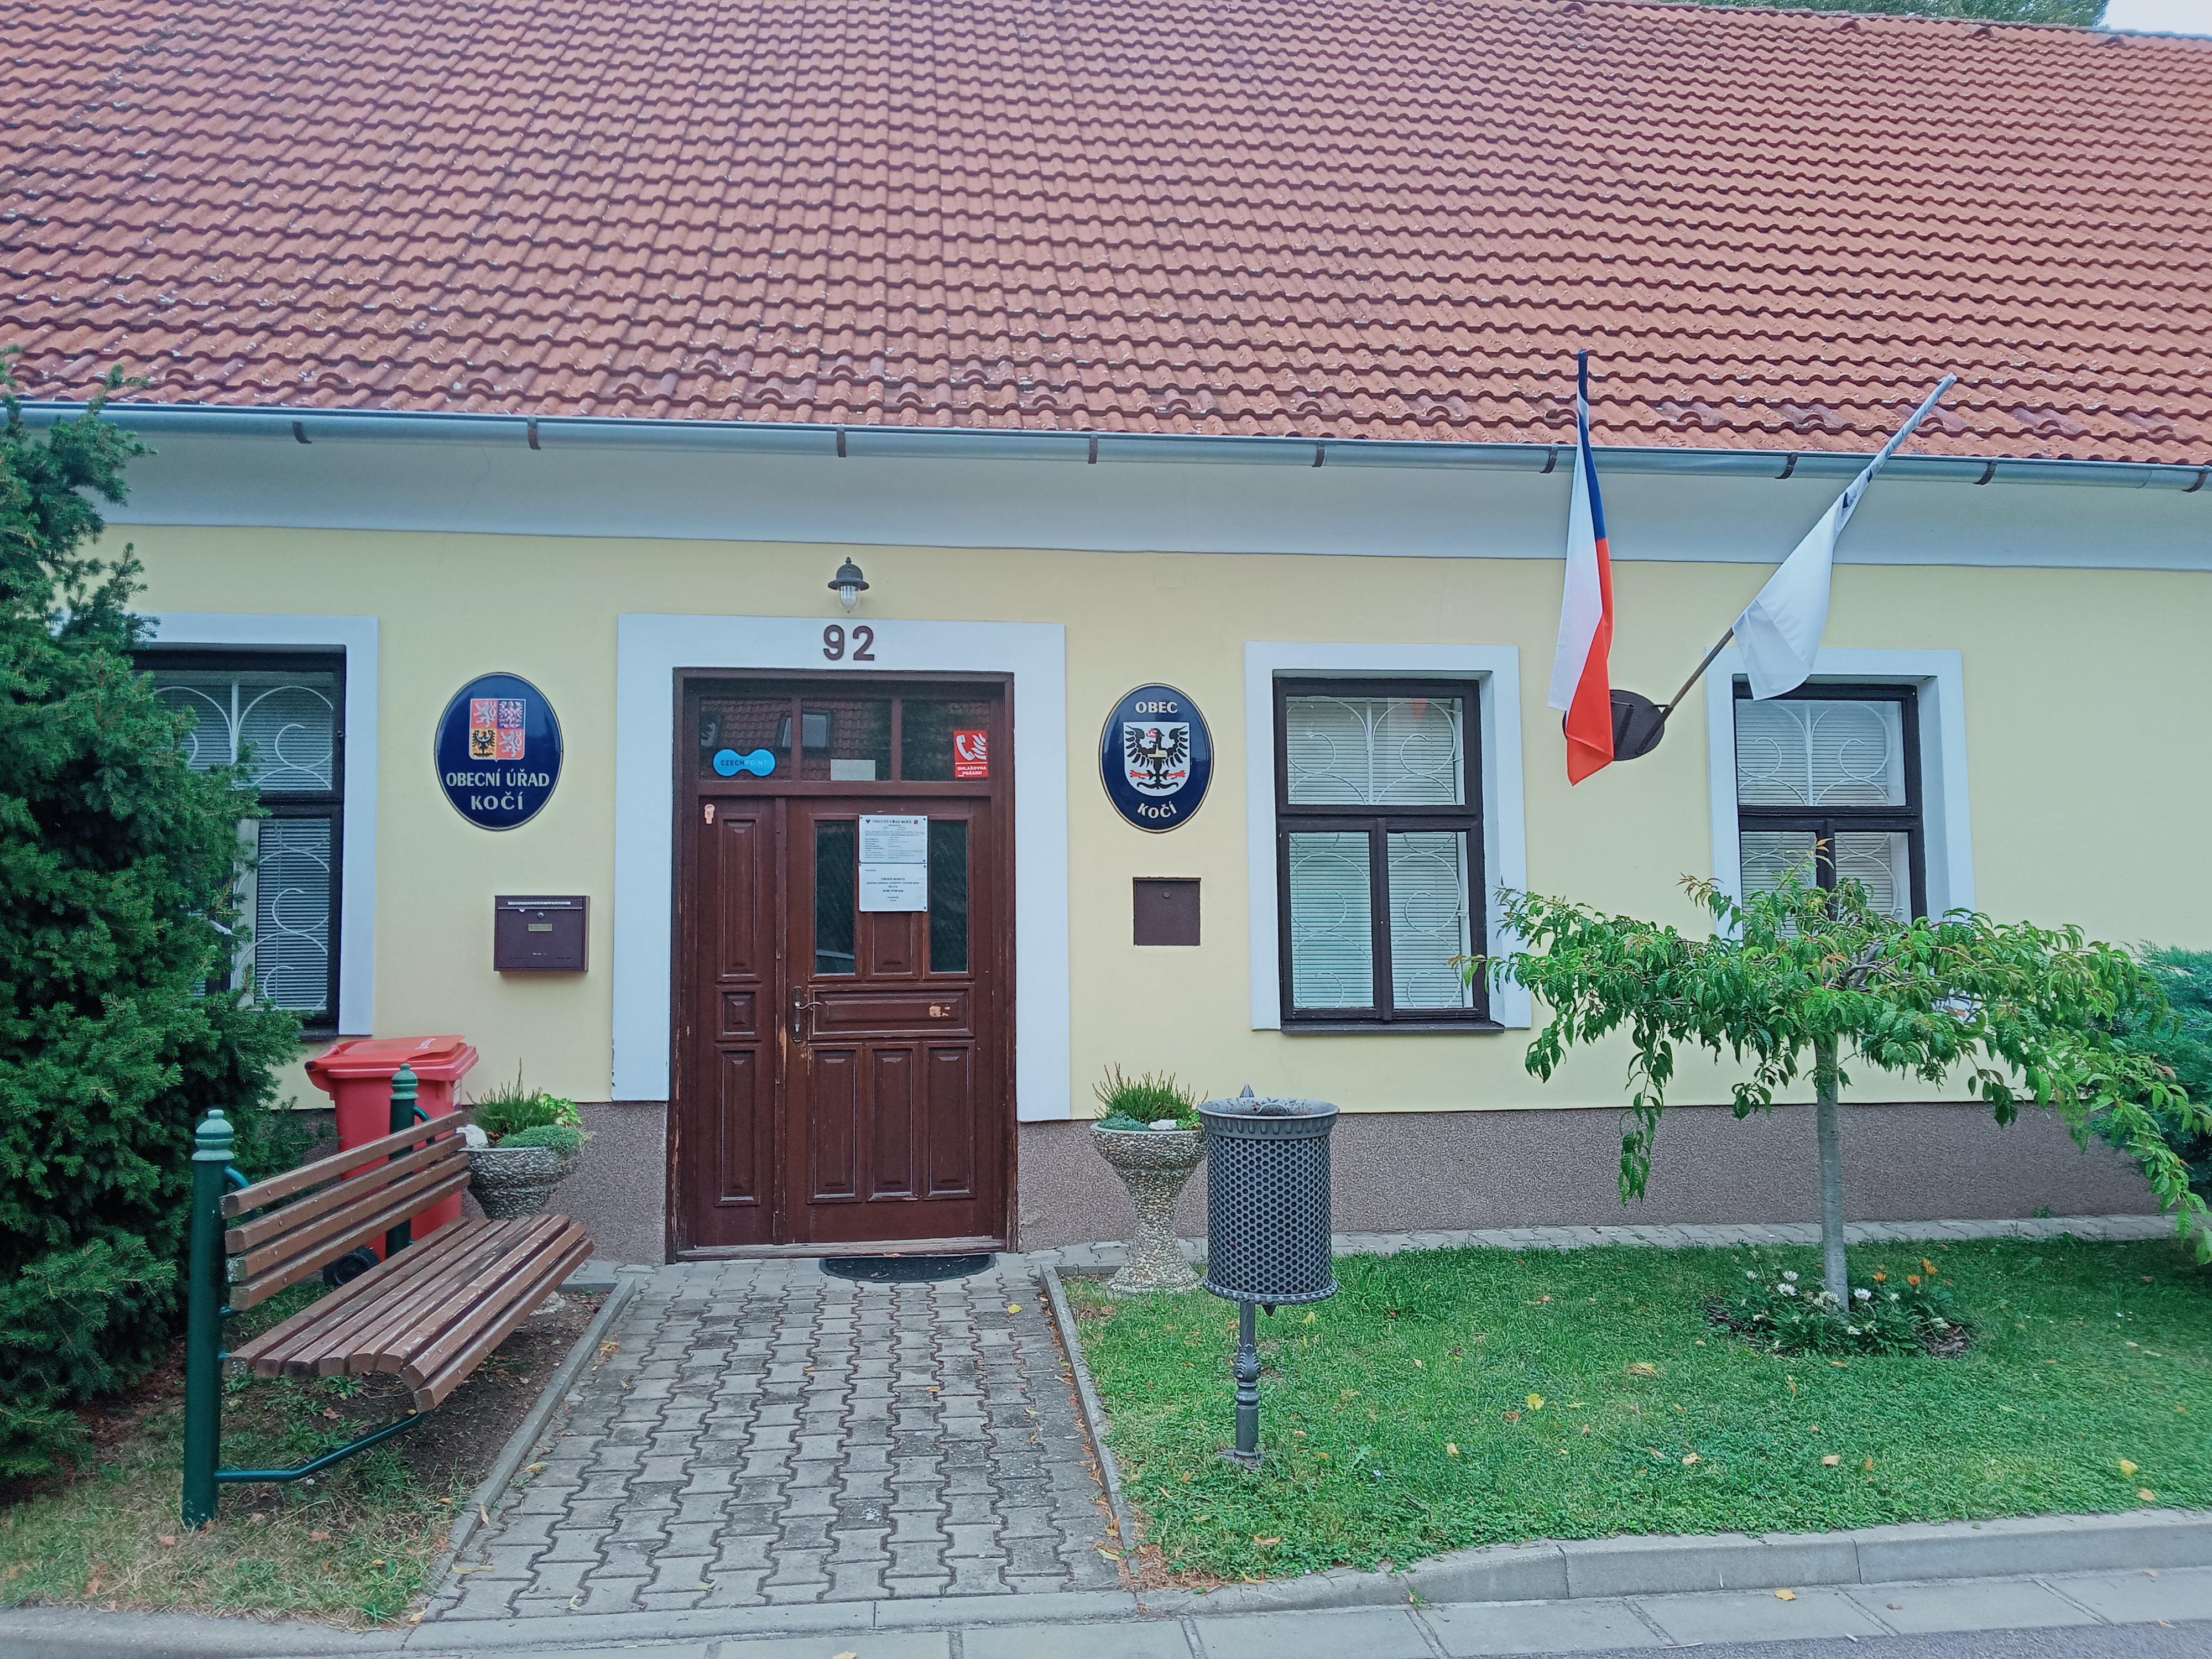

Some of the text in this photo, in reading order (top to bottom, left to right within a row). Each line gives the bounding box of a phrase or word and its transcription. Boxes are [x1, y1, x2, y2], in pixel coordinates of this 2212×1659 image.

[823, 624, 875, 661] 92
[1135, 701, 1178, 713] OBEC
[446, 768, 550, 787] OBECNÍ ÚŘAD
[471, 791, 523, 810] KOČÍ
[1137, 800, 1177, 819] KOČÍ
